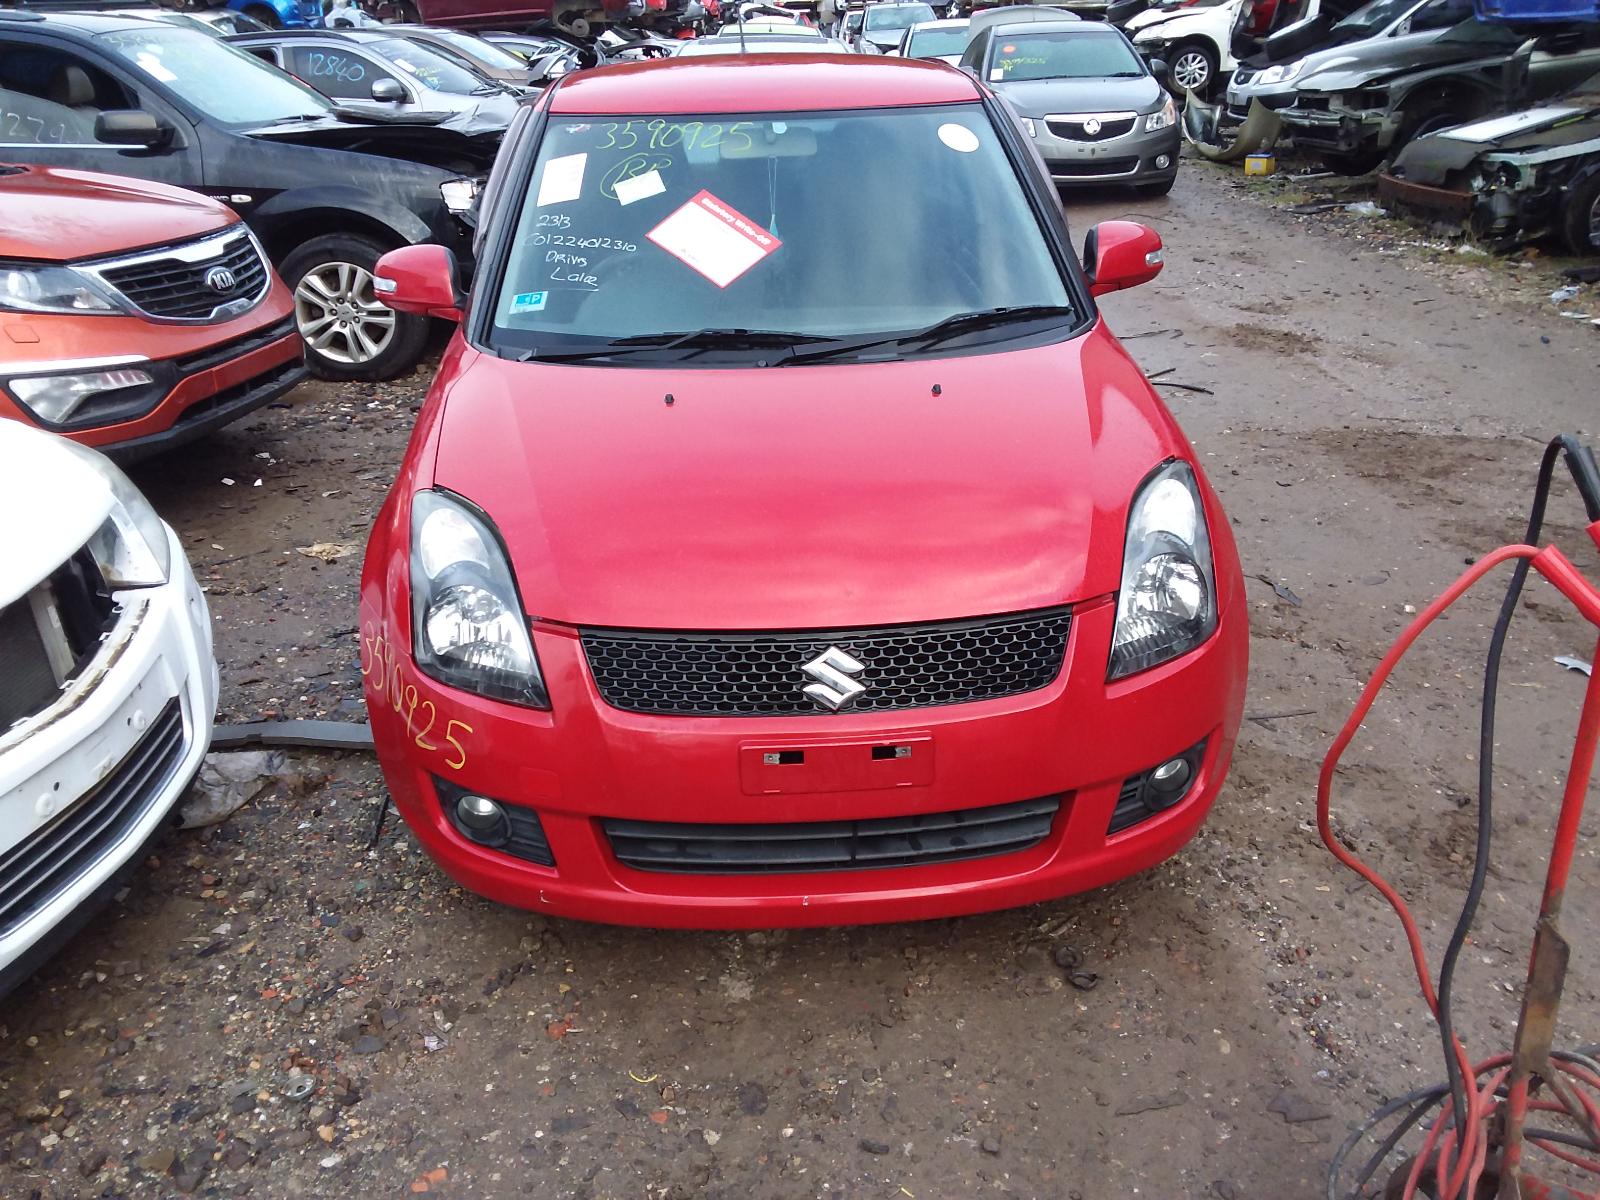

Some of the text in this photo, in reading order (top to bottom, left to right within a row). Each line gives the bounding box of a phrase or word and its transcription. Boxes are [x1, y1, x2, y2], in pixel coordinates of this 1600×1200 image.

[309, 52, 365, 82] 12840
[595, 118, 754, 150] 3590925
[211, 270, 235, 290] KIA
[361, 620, 474, 770] 3590925
